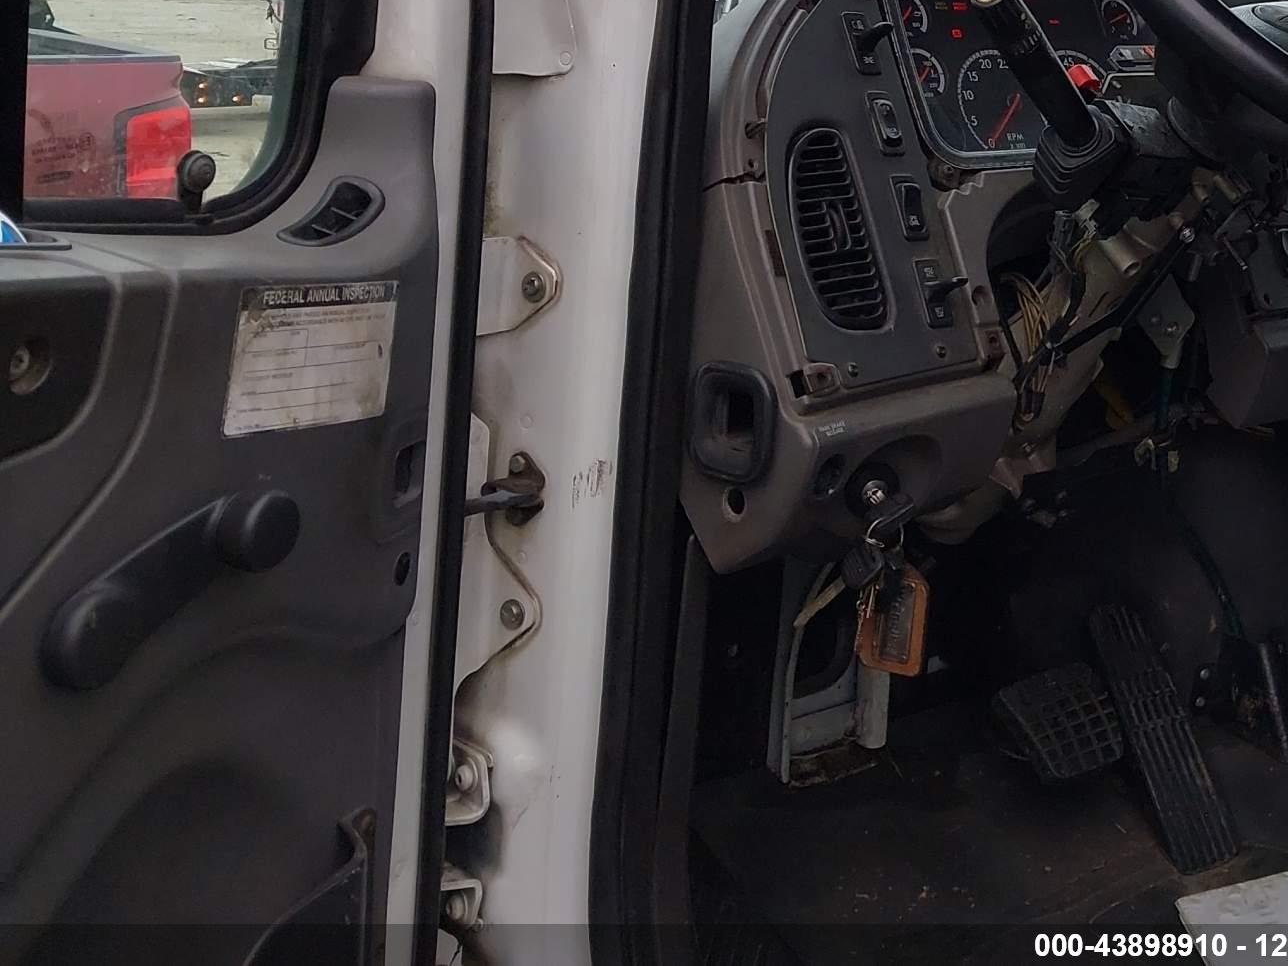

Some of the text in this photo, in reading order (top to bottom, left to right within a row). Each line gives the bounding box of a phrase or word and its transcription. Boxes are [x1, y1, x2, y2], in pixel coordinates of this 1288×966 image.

[980, 59, 992, 69] 20
[1063, 57, 1075, 66] 45
[967, 71, 979, 82] 15
[962, 90, 974, 100] 10
[971, 115, 978, 126] 5
[1006, 133, 1024, 141] RPM
[988, 138, 995, 148] 0
[263, 285, 385, 305] FEDERAL ANNUAL INSPECTION
